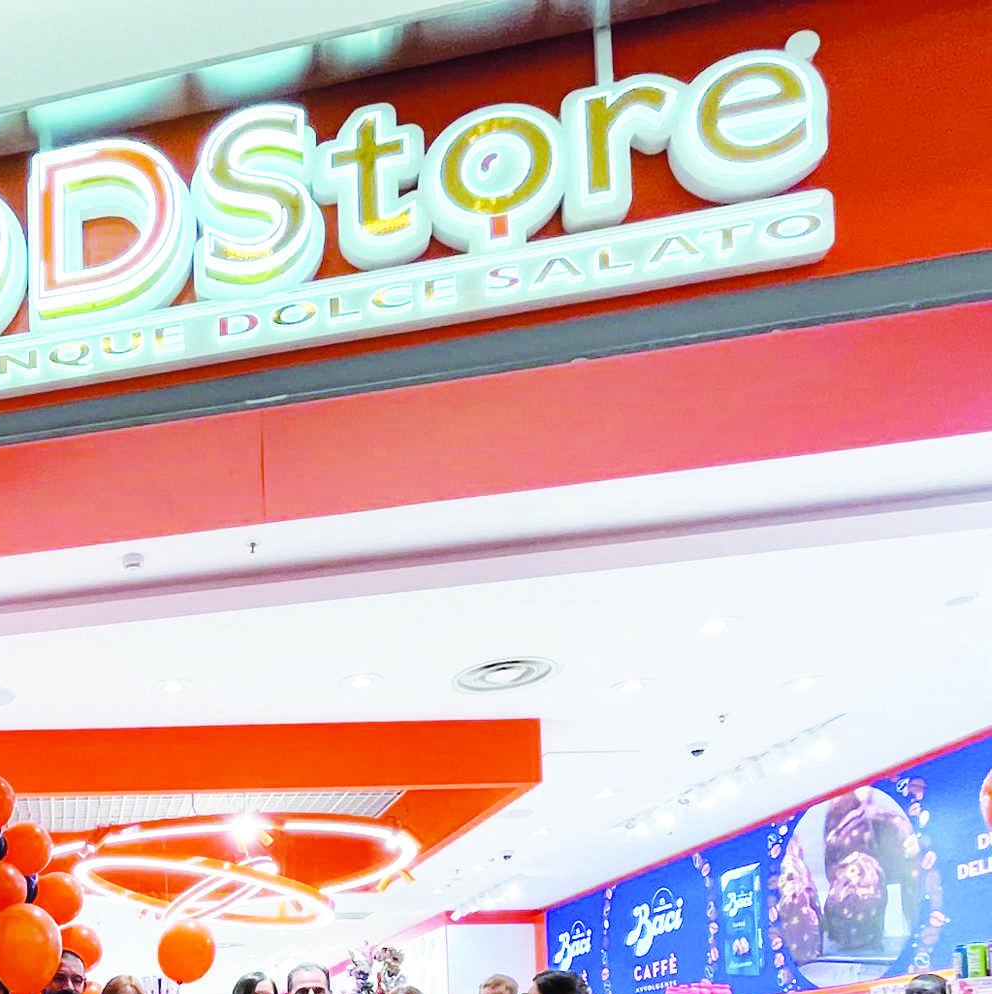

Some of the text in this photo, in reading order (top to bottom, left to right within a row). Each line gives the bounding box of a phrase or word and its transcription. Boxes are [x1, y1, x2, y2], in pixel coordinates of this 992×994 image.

[219, 276, 456, 337] DOLCE
[486, 213, 822, 288] SALATO
[977, 831, 992, 850] D
[722, 890, 754, 918] Baci
[625, 897, 684, 957] Baci
[553, 928, 593, 971] Baci
[633, 953, 678, 981] CAFFÈ
